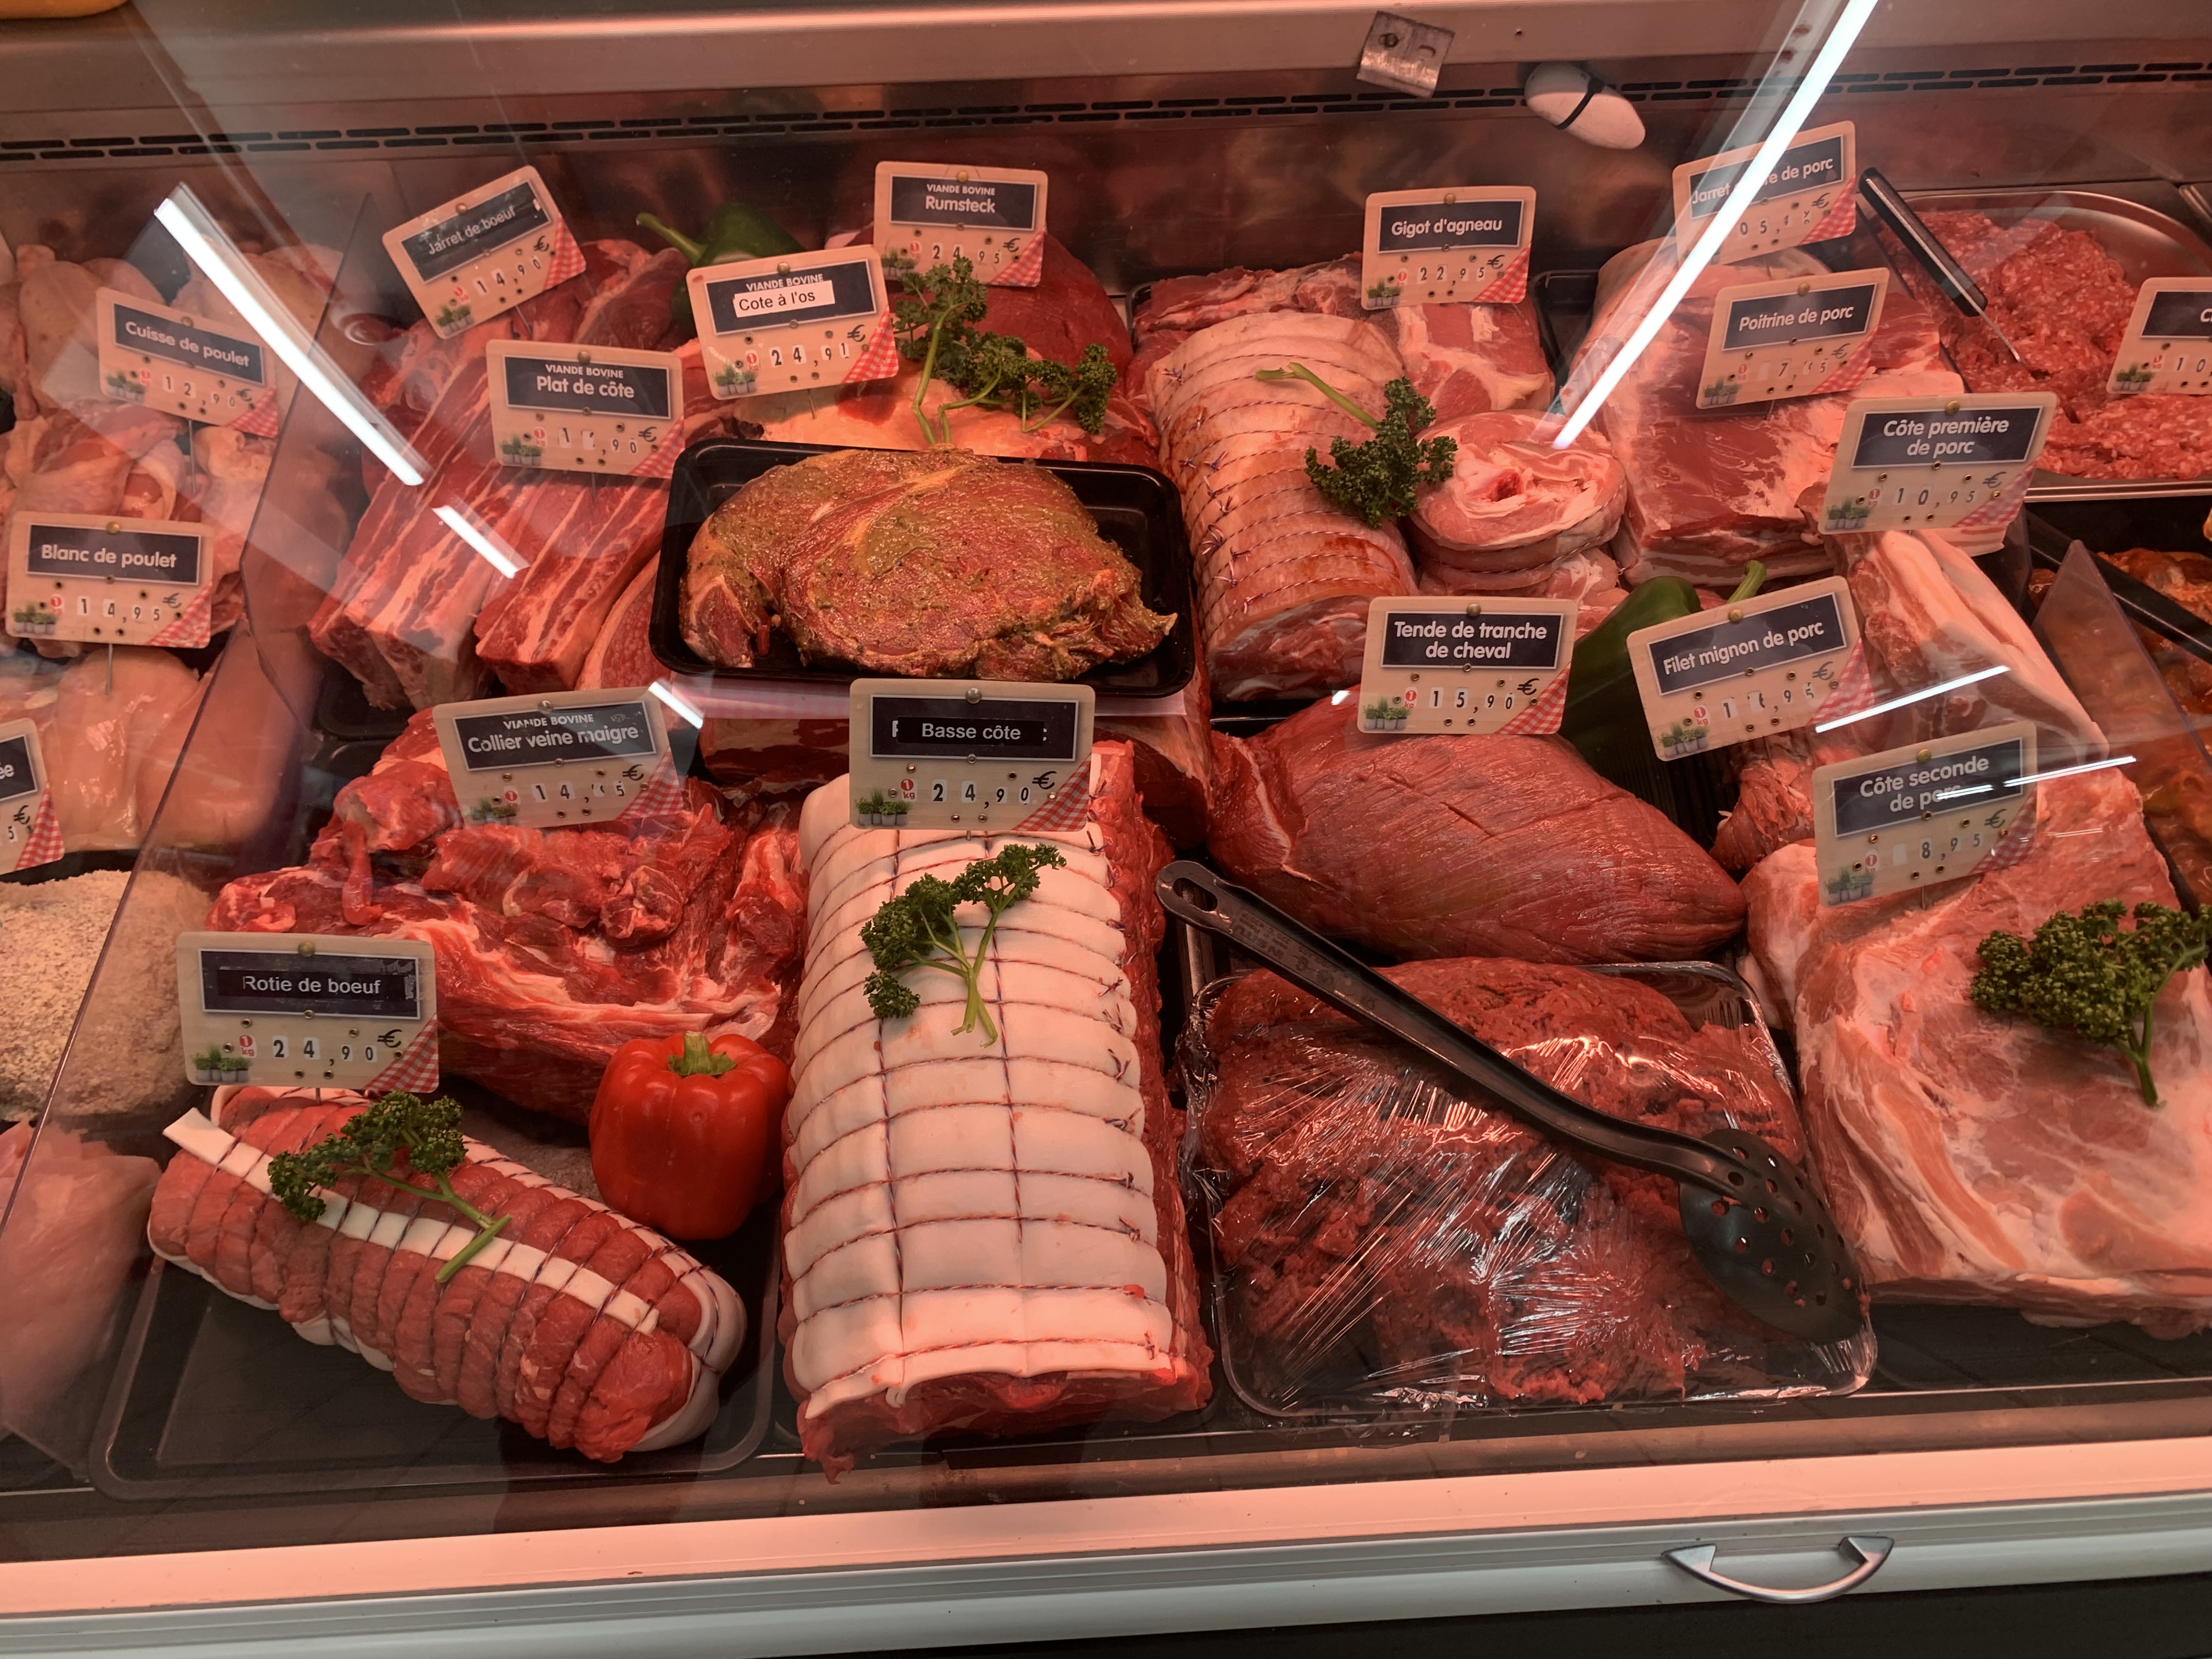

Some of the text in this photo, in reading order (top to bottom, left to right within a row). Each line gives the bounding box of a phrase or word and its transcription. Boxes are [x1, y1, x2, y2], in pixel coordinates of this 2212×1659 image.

[927, 184, 996, 196] VIANDE BOVINE
[1692, 157, 1833, 204] Jarret de porc
[926, 196, 995, 213] Rumsteck
[428, 205, 516, 255] Jarret de boeuf
[1391, 218, 1503, 238] Gigot d'agneau
[746, 274, 823, 292] VIANDE BOVINE
[739, 291, 816, 311] Cote à l'os
[1739, 306, 1854, 331] Poitrine de porc
[125, 321, 250, 367] Cuisse de poulet
[545, 364, 624, 379] VIANDE BOVINE
[537, 376, 635, 398] Plat de côte
[1883, 416, 2010, 439] Côte première
[1907, 440, 1974, 459] de porc
[41, 545, 177, 568] Blanc de poulet
[1394, 620, 1547, 640] Tende de tranche
[1425, 641, 1511, 659] de cheval
[1663, 621, 1825, 676] Filet mignon de porc
[503, 714, 594, 730] VIANDE BOVINE
[922, 723, 1022, 741] Basse côte
[468, 726, 639, 753] Collier veine maigre
[1860, 756, 1989, 798] Côte seconde
[1889, 794, 1914, 812] de
[242, 975, 381, 995] Rotie de boeuf
